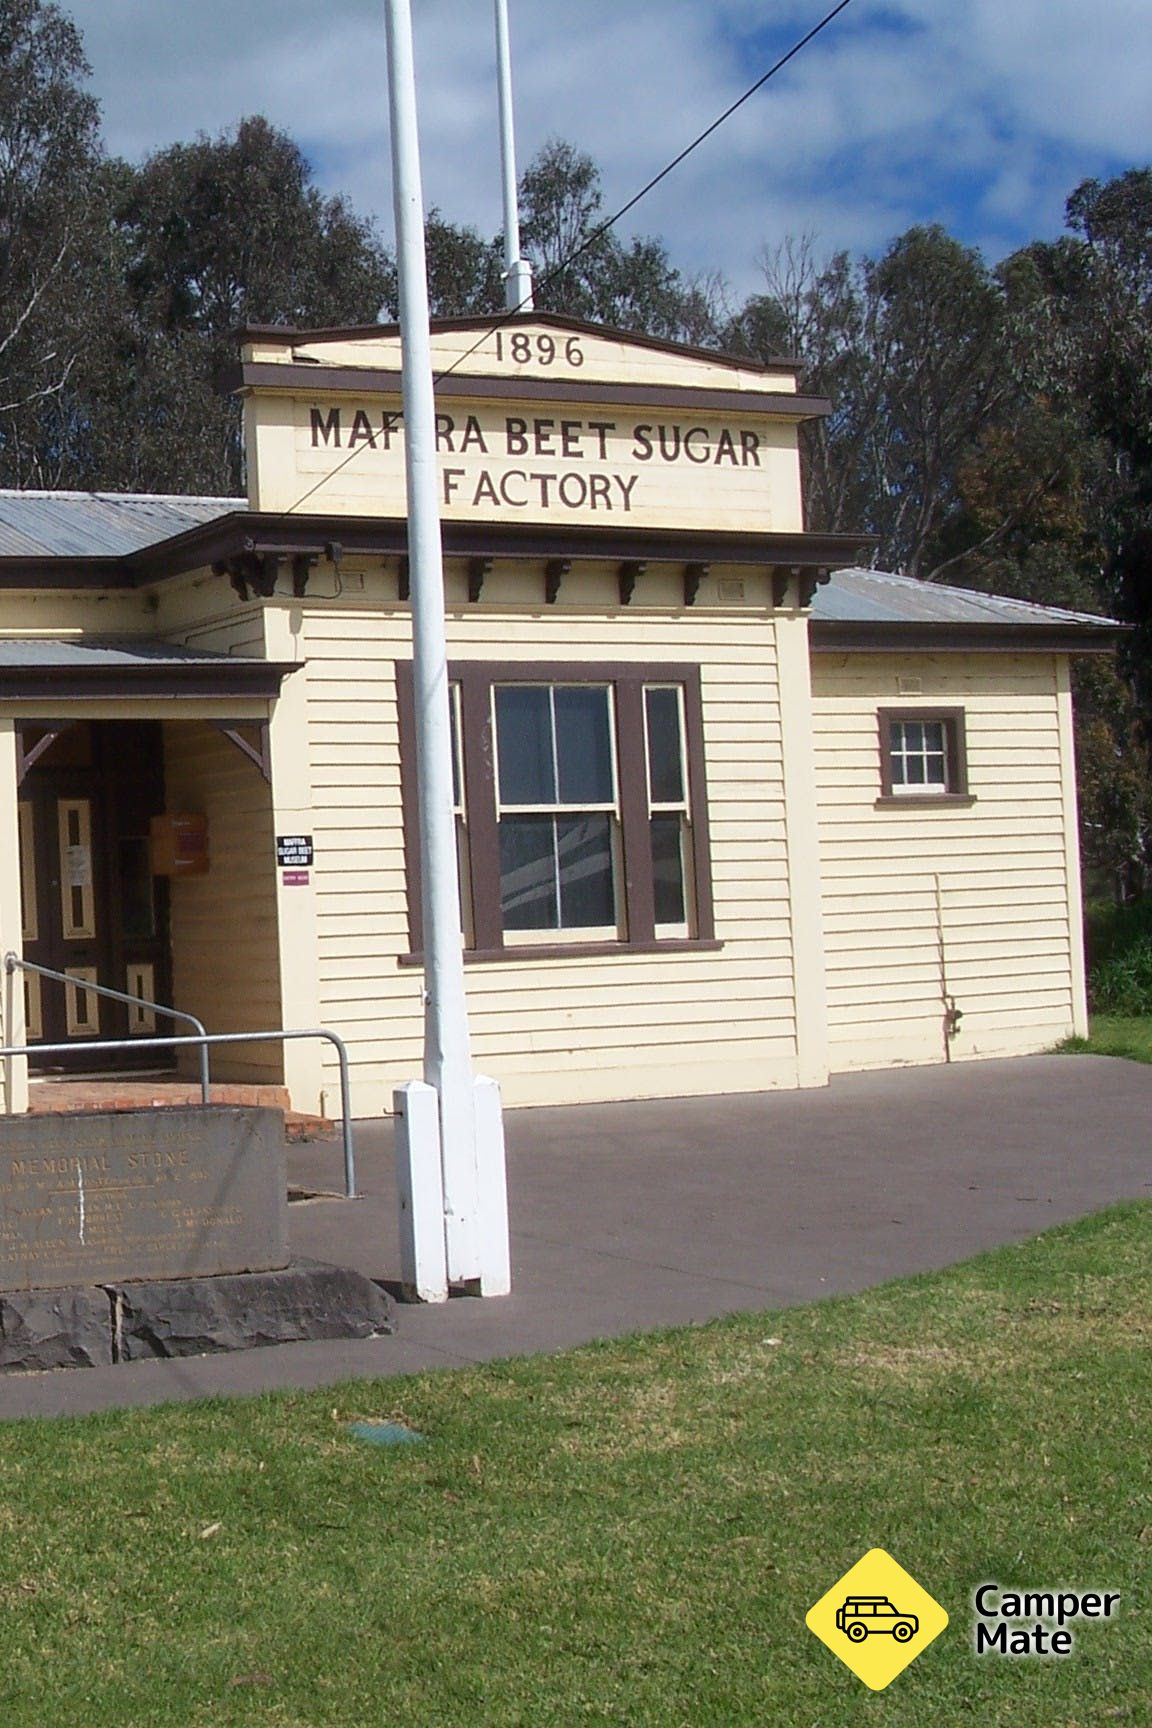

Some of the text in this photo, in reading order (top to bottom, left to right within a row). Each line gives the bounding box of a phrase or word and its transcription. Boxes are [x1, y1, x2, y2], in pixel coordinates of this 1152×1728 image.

[497, 332, 584, 367] 1896
[310, 408, 761, 466] MAFRA BEET SUGAR
[443, 468, 638, 511] FACTORY
[11, 1151, 189, 1176] MEMORIAL STONE
